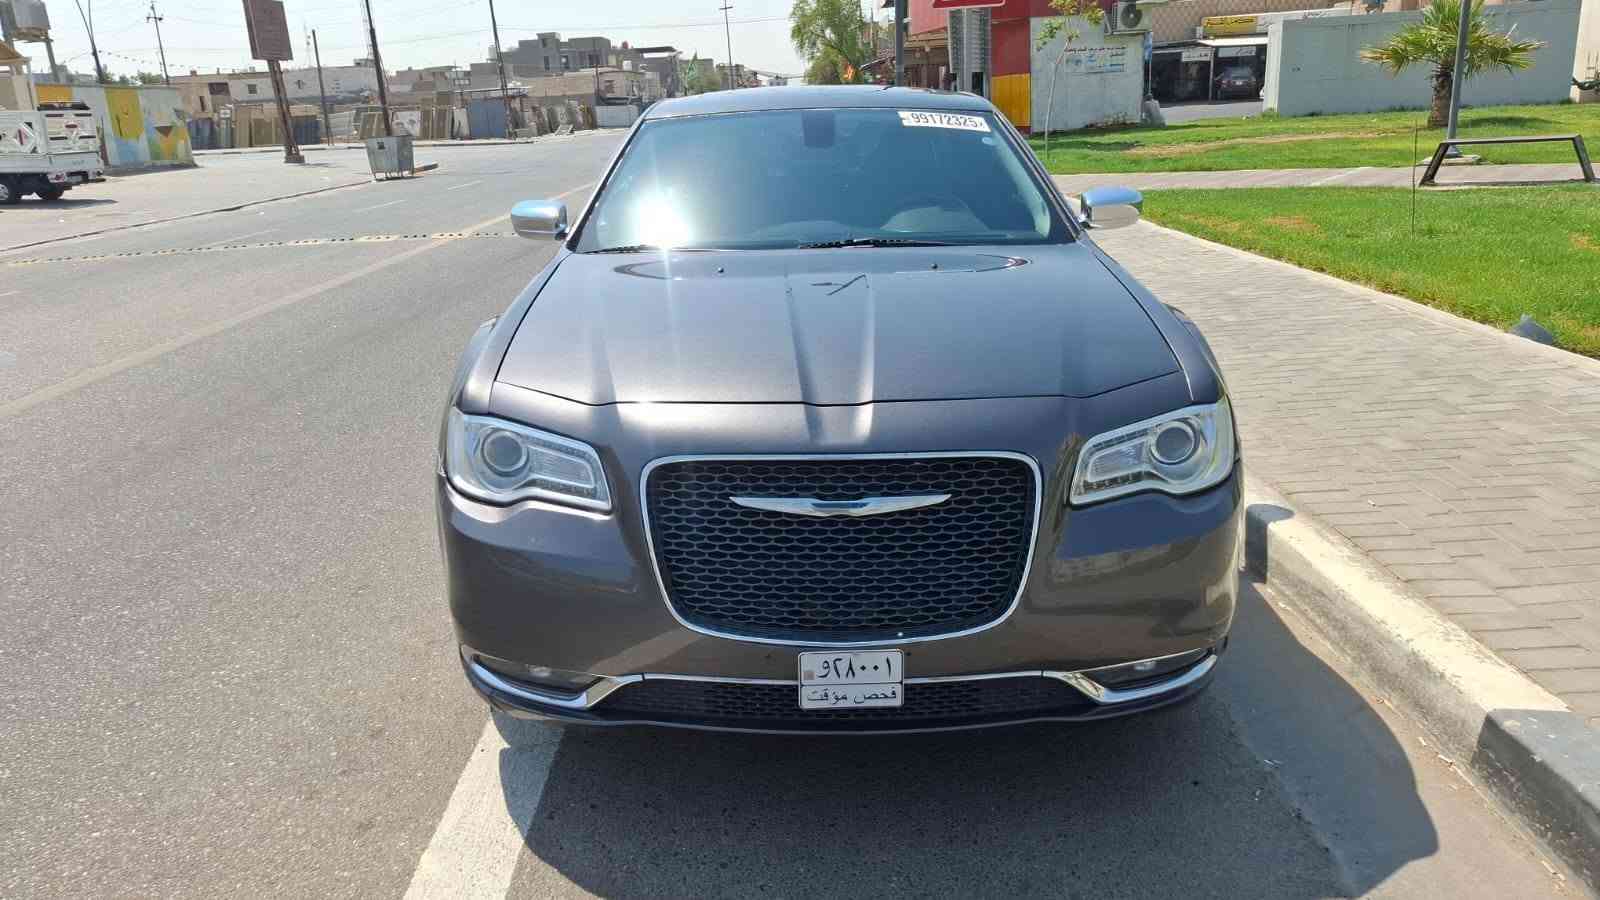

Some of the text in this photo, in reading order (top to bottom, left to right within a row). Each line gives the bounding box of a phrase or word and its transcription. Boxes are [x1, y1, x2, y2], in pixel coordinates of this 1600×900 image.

[911, 112, 978, 128] 99172325
[806, 686, 897, 705] فحص مؤقت
